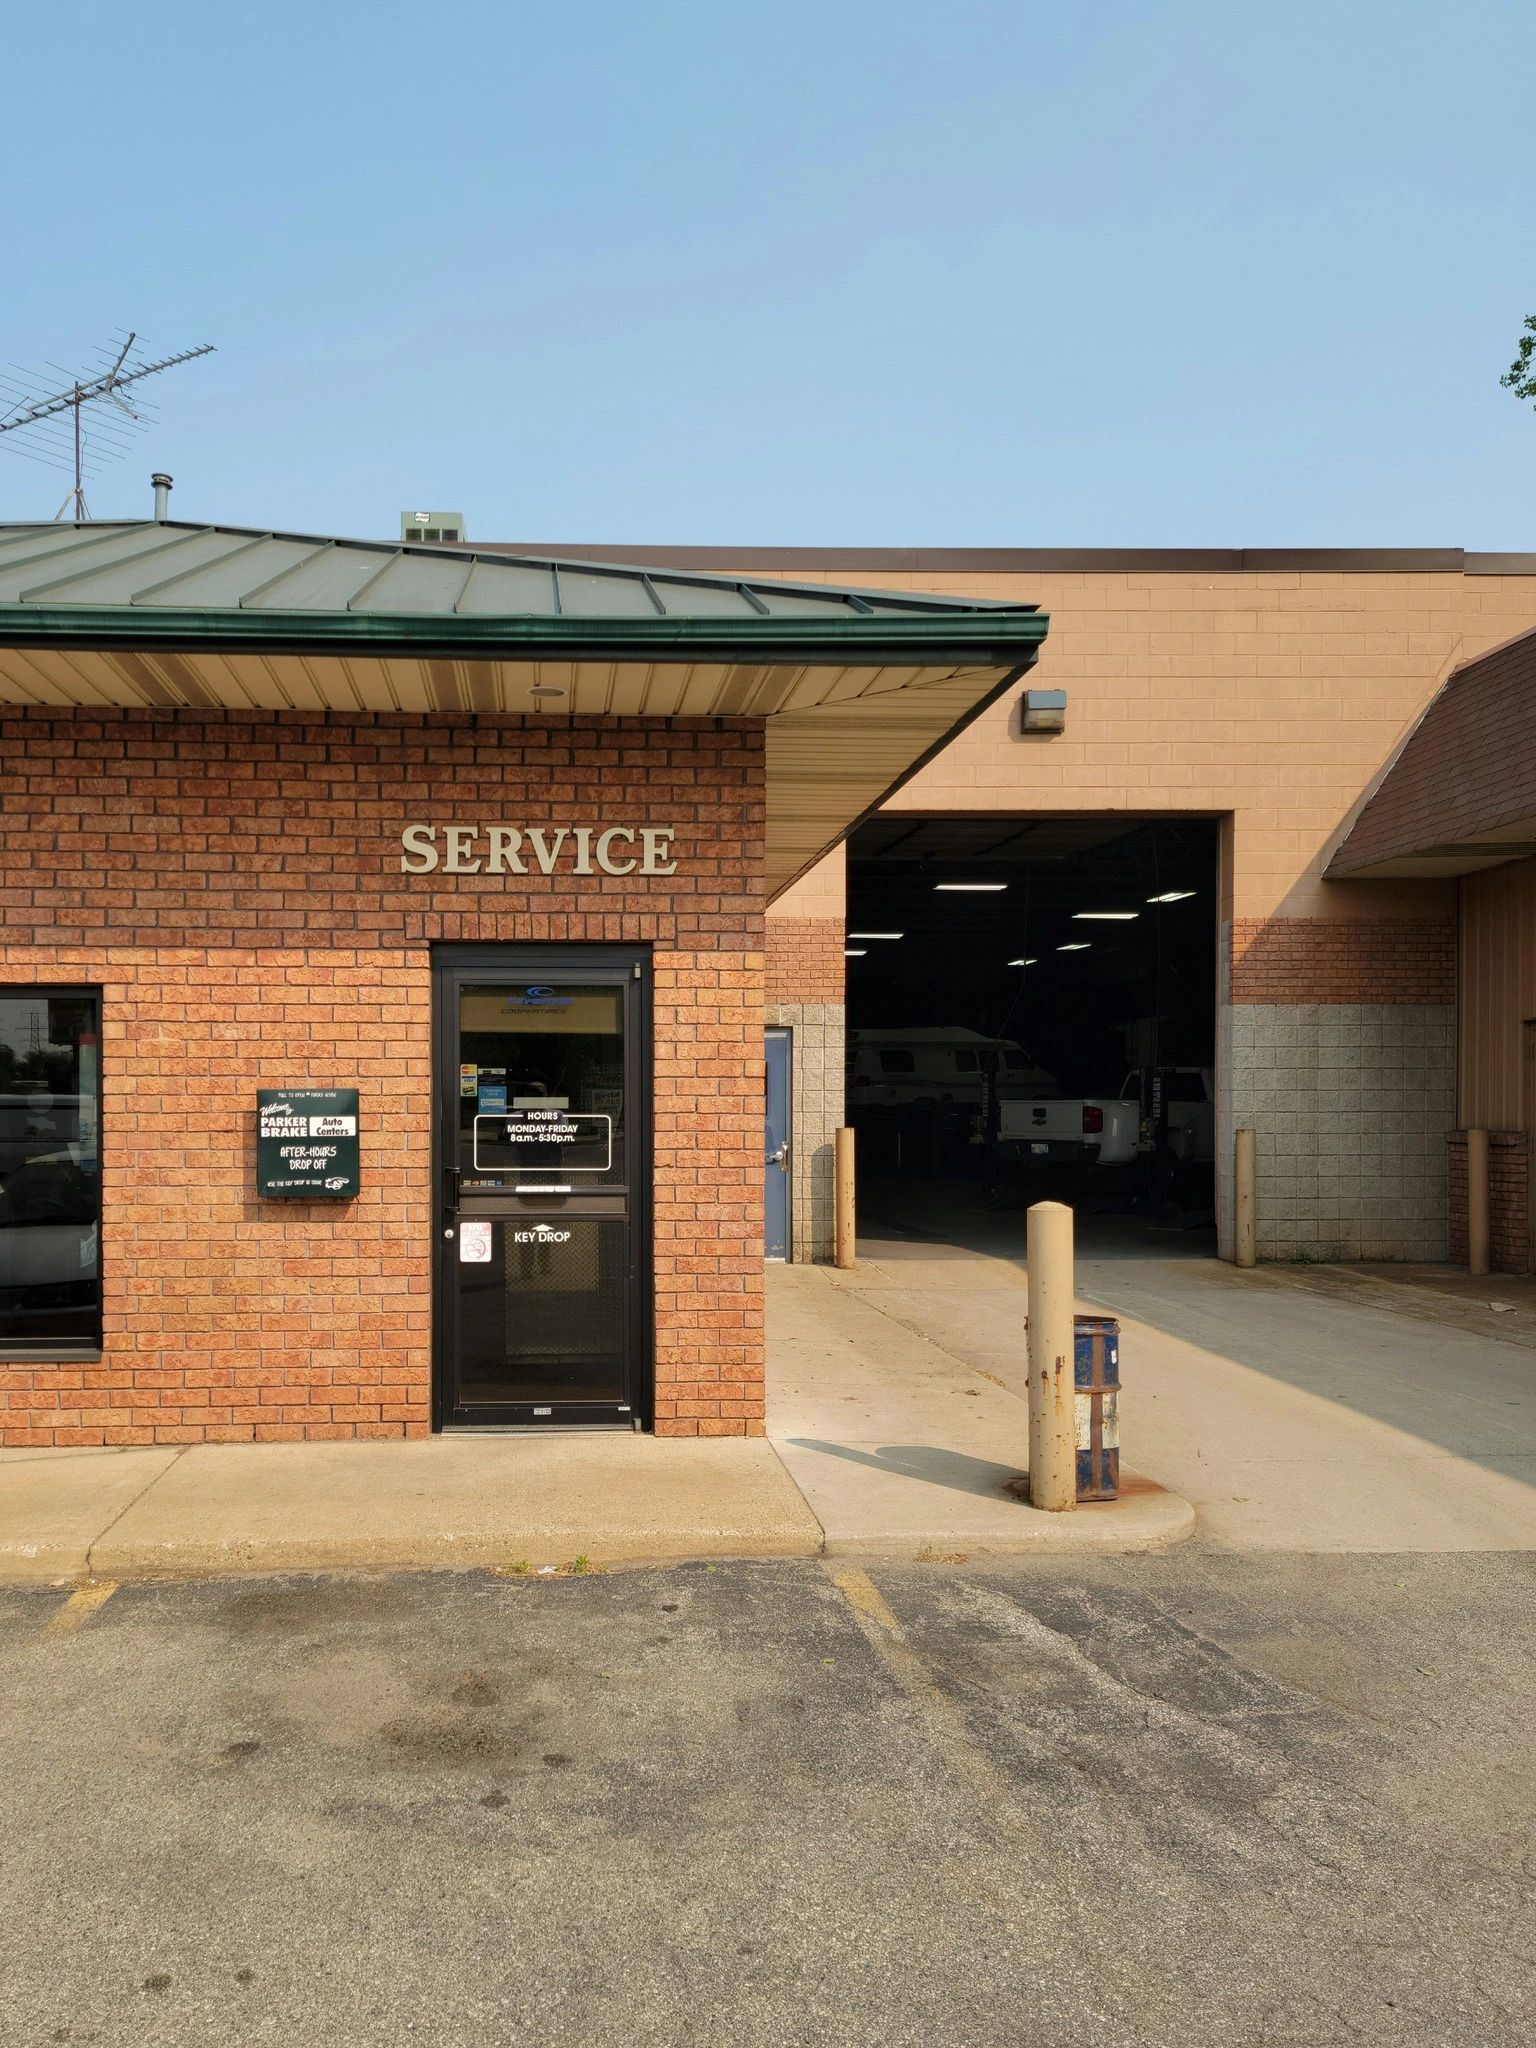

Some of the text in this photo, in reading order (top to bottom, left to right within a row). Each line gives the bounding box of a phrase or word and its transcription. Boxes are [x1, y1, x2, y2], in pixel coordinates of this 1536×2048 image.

[401, 825, 678, 875] SERVICE
[260, 1103, 290, 1116] Welcome
[527, 1112, 558, 1120] HOURS
[261, 1117, 307, 1127] PARKER
[322, 1118, 343, 1126] Auto
[261, 1127, 308, 1137] BRAKE
[316, 1128, 349, 1136] Centers
[507, 1124, 578, 1133] MONDAY-FRIDAY
[280, 1146, 337, 1157] AFTER-HOURS
[289, 1159, 327, 1170] DROP OFF
[514, 1232, 571, 1243] KEY DROP
